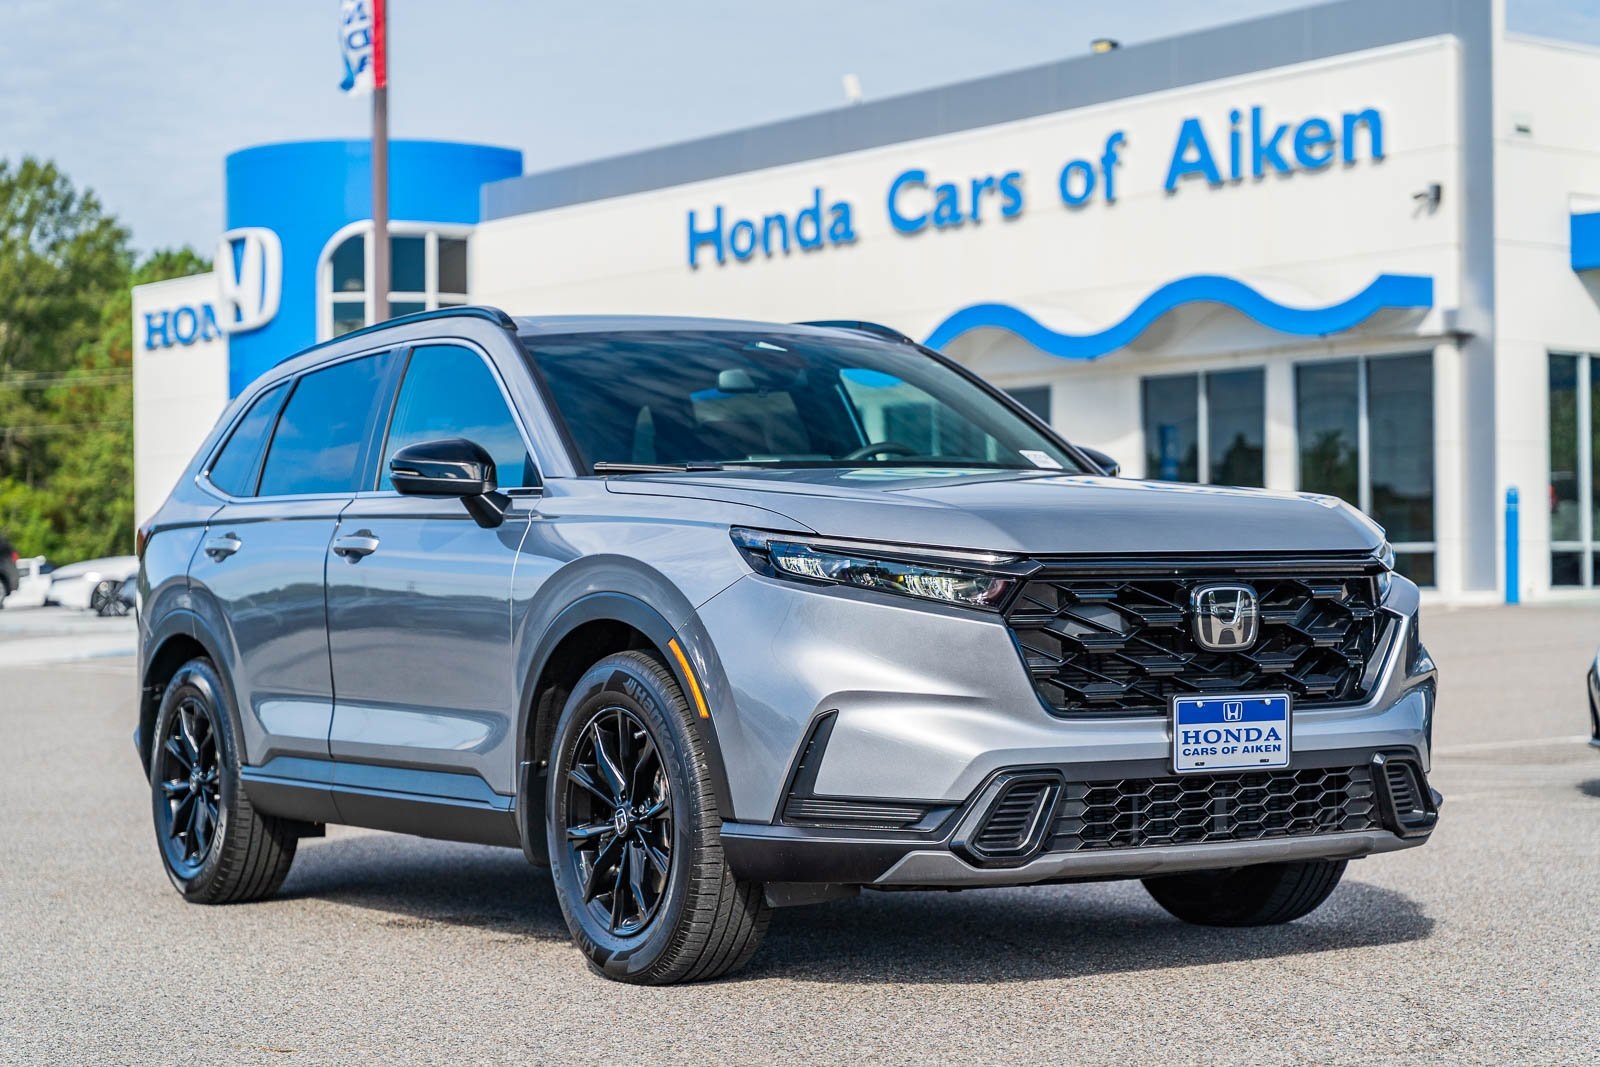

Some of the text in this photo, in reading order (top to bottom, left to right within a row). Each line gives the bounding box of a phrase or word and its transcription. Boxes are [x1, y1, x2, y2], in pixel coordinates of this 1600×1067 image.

[687, 104, 1384, 266] Honda Cars of Aiken
[1181, 726, 1282, 745] HONDA
[1182, 743, 1282, 757] CARS OF AIKEN
